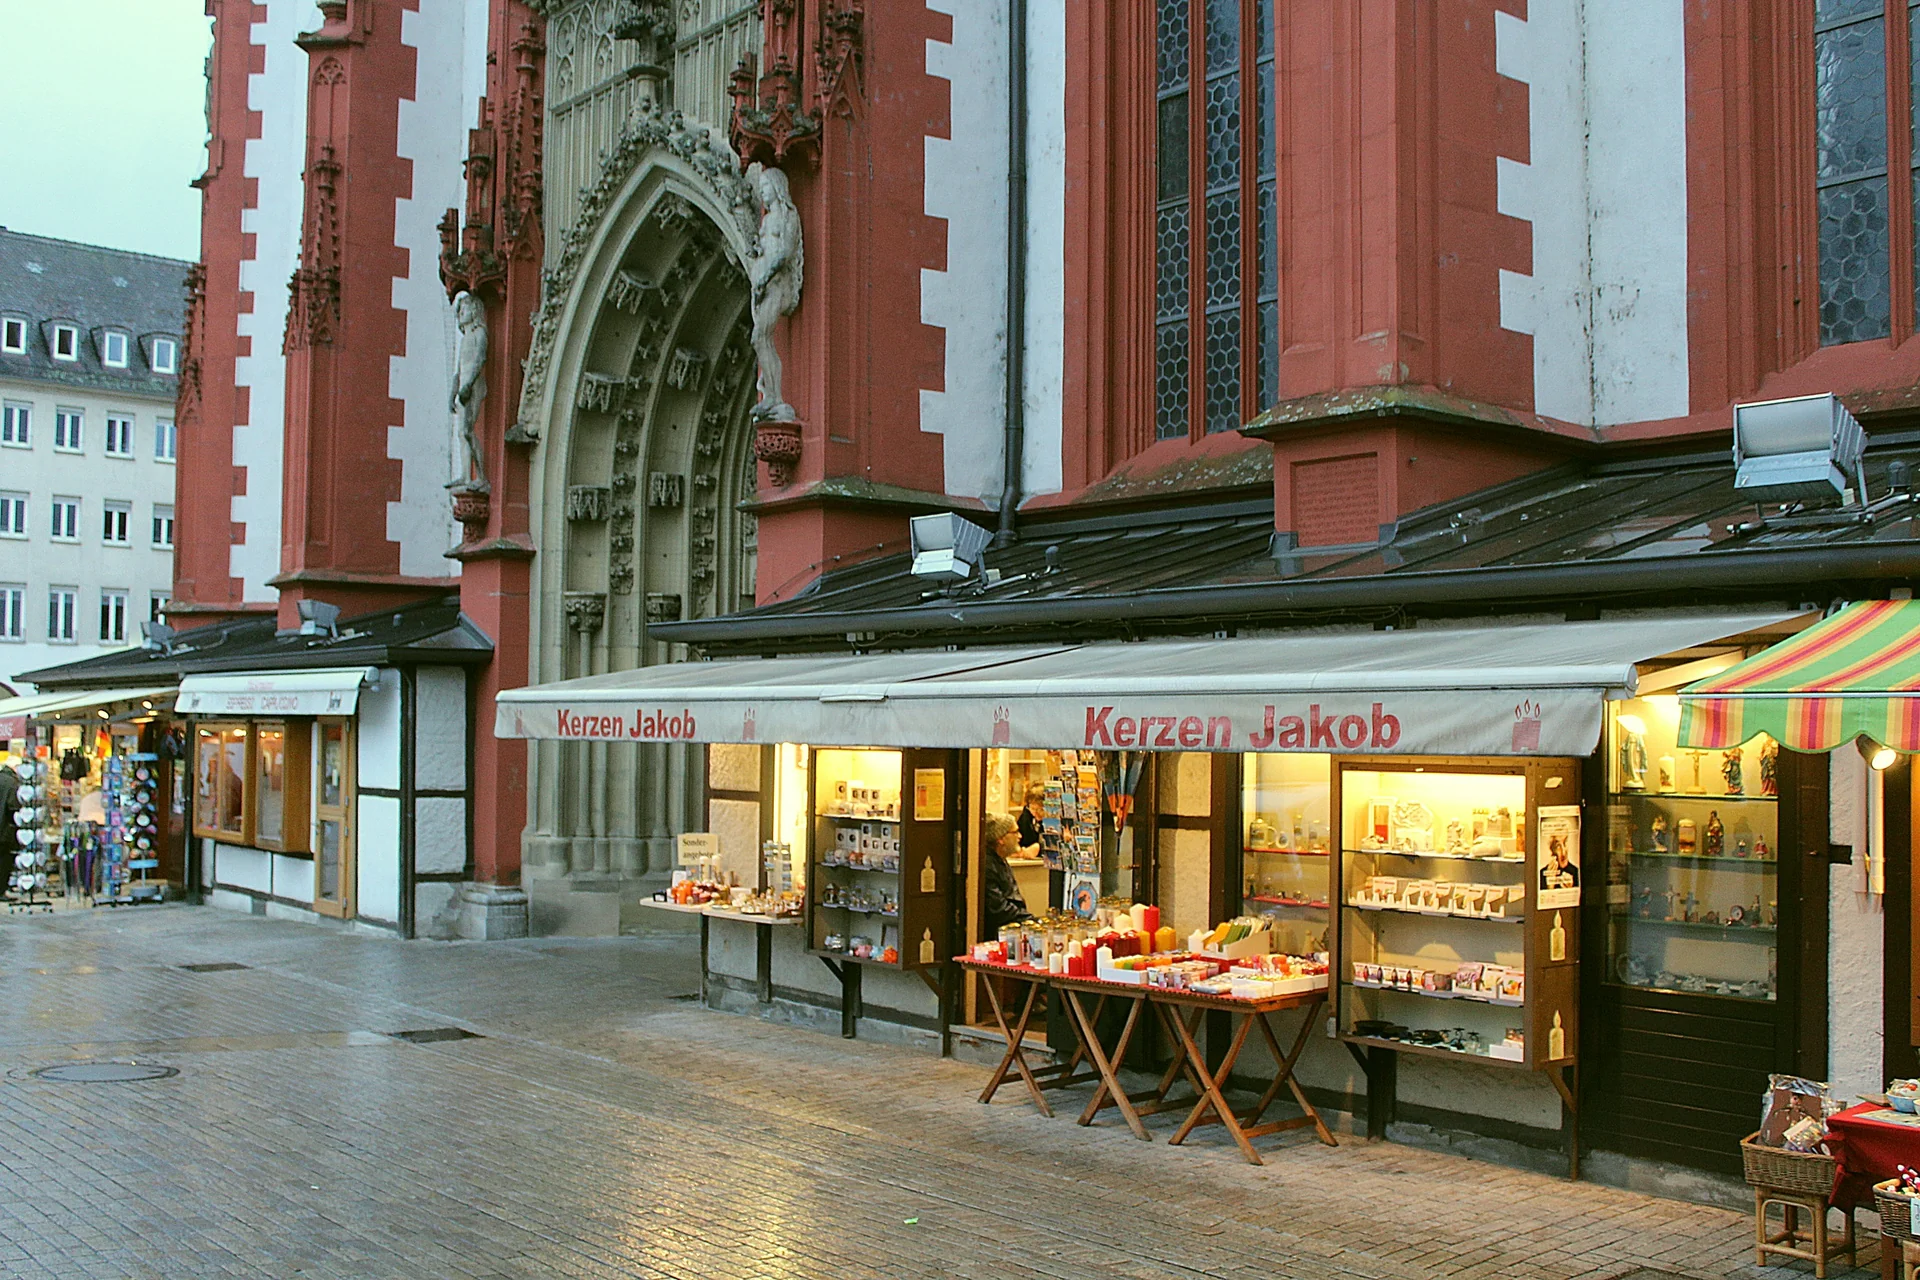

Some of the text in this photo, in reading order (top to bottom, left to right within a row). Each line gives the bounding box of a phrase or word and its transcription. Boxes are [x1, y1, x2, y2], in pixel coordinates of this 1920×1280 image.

[557, 708, 696, 739] Kerzen Jakob
[1084, 702, 1401, 749] Kerzen Jakob
